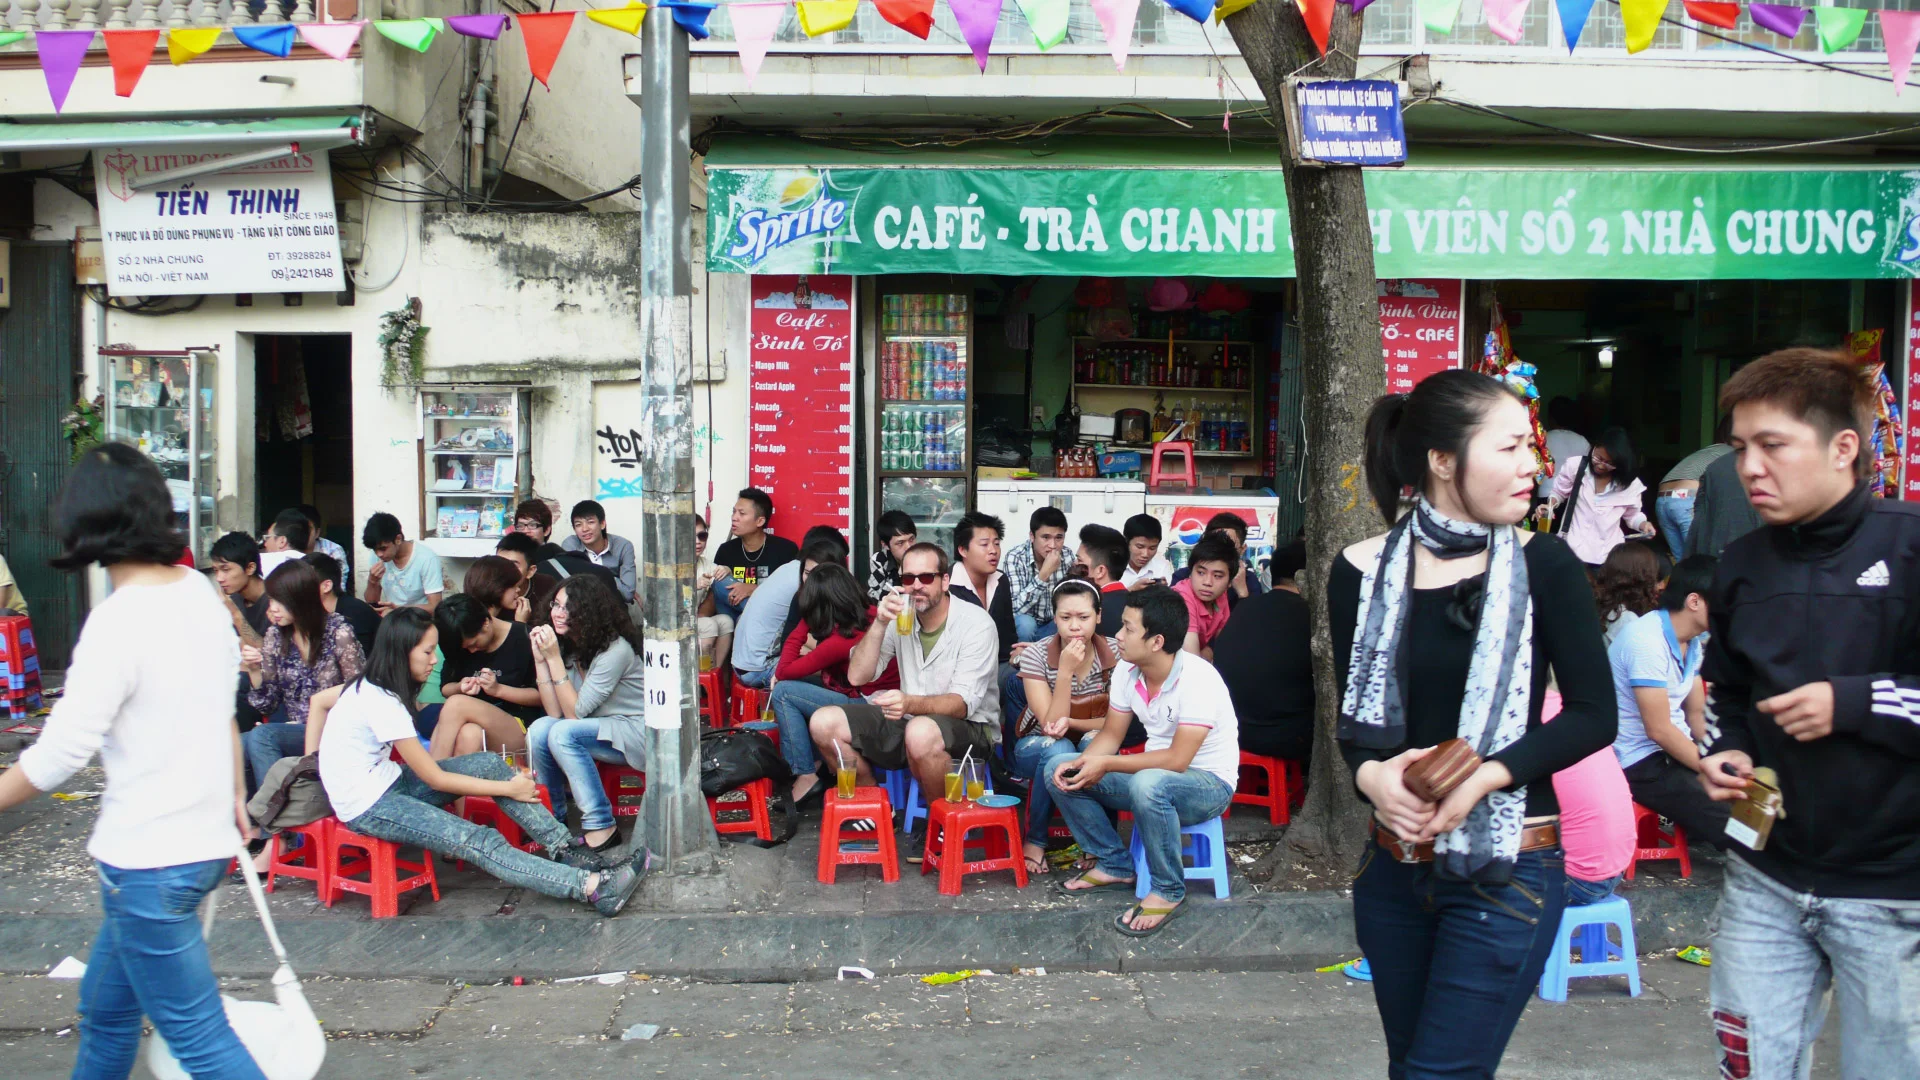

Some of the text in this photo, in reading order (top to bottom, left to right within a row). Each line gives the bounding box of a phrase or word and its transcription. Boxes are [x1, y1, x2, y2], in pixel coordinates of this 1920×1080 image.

[155, 181, 300, 219] TIẾN THỊNH
[283, 211, 334, 221] SINCE 1949
[728, 188, 847, 266] Sprite
[874, 193, 986, 250] CAFÉ
[1019, 193, 1109, 252] TRÀ
[1120, 207, 1277, 253] CHANH
[1404, 195, 1508, 254] VIÊN
[1521, 189, 1577, 255] SỐ
[1587, 217, 1610, 257] 2
[1621, 196, 1716, 255] NHÀ
[1726, 209, 1876, 255] CHUNG
[135, 256, 140, 265] 2
[167, 254, 204, 264] CHUNG
[185, 272, 209, 281] NAM
[1418, 303, 1458, 319] Viên
[776, 311, 828, 330] Café
[1415, 326, 1455, 341] CAFÉ
[755, 334, 849, 351] Sinh Tố
[755, 361, 775, 371] Mango
[776, 361, 789, 370] Milk
[755, 381, 778, 391] Custard
[778, 382, 796, 392] Apple
[754, 402, 780, 412] Avocado
[754, 423, 777, 432] Banana
[754, 444, 768, 453] Pine
[769, 444, 786, 453] Apple
[754, 464, 775, 474] Grapes
[650, 689, 666, 706] 10
